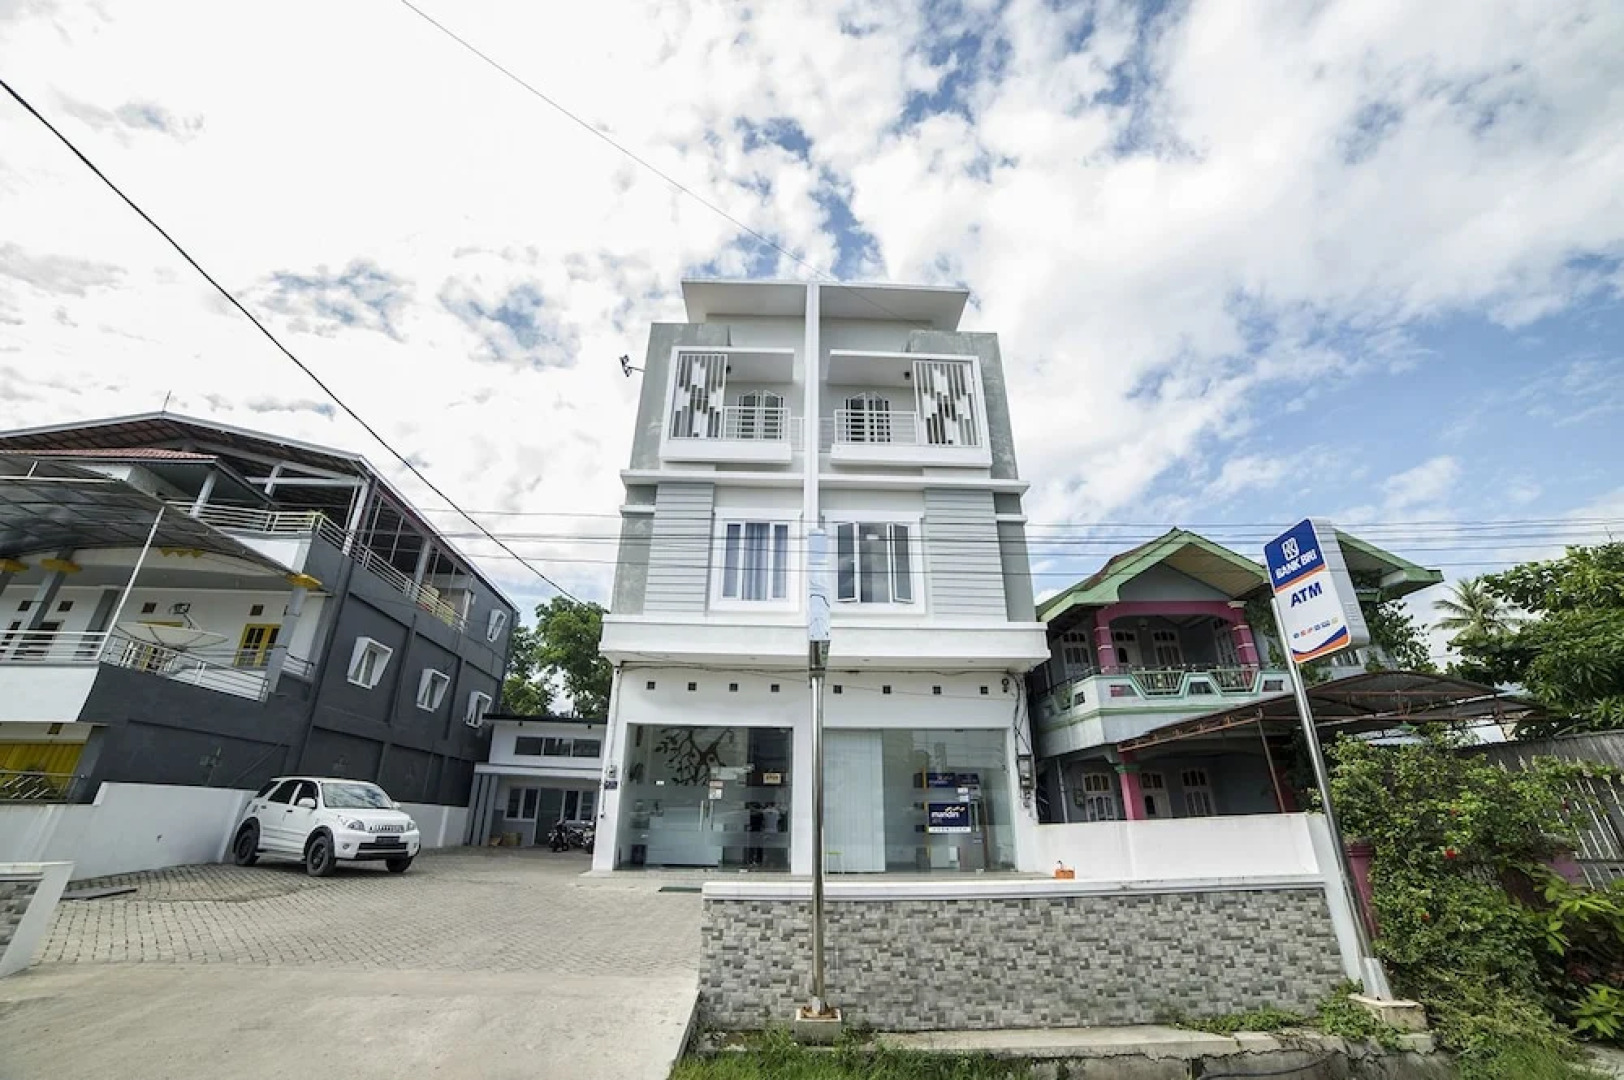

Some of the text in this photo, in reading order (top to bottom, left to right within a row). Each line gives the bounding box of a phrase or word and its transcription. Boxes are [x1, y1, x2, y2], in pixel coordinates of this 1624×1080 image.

[1275, 549, 1317, 578] BANK BRI
[1291, 582, 1322, 607] ATM
